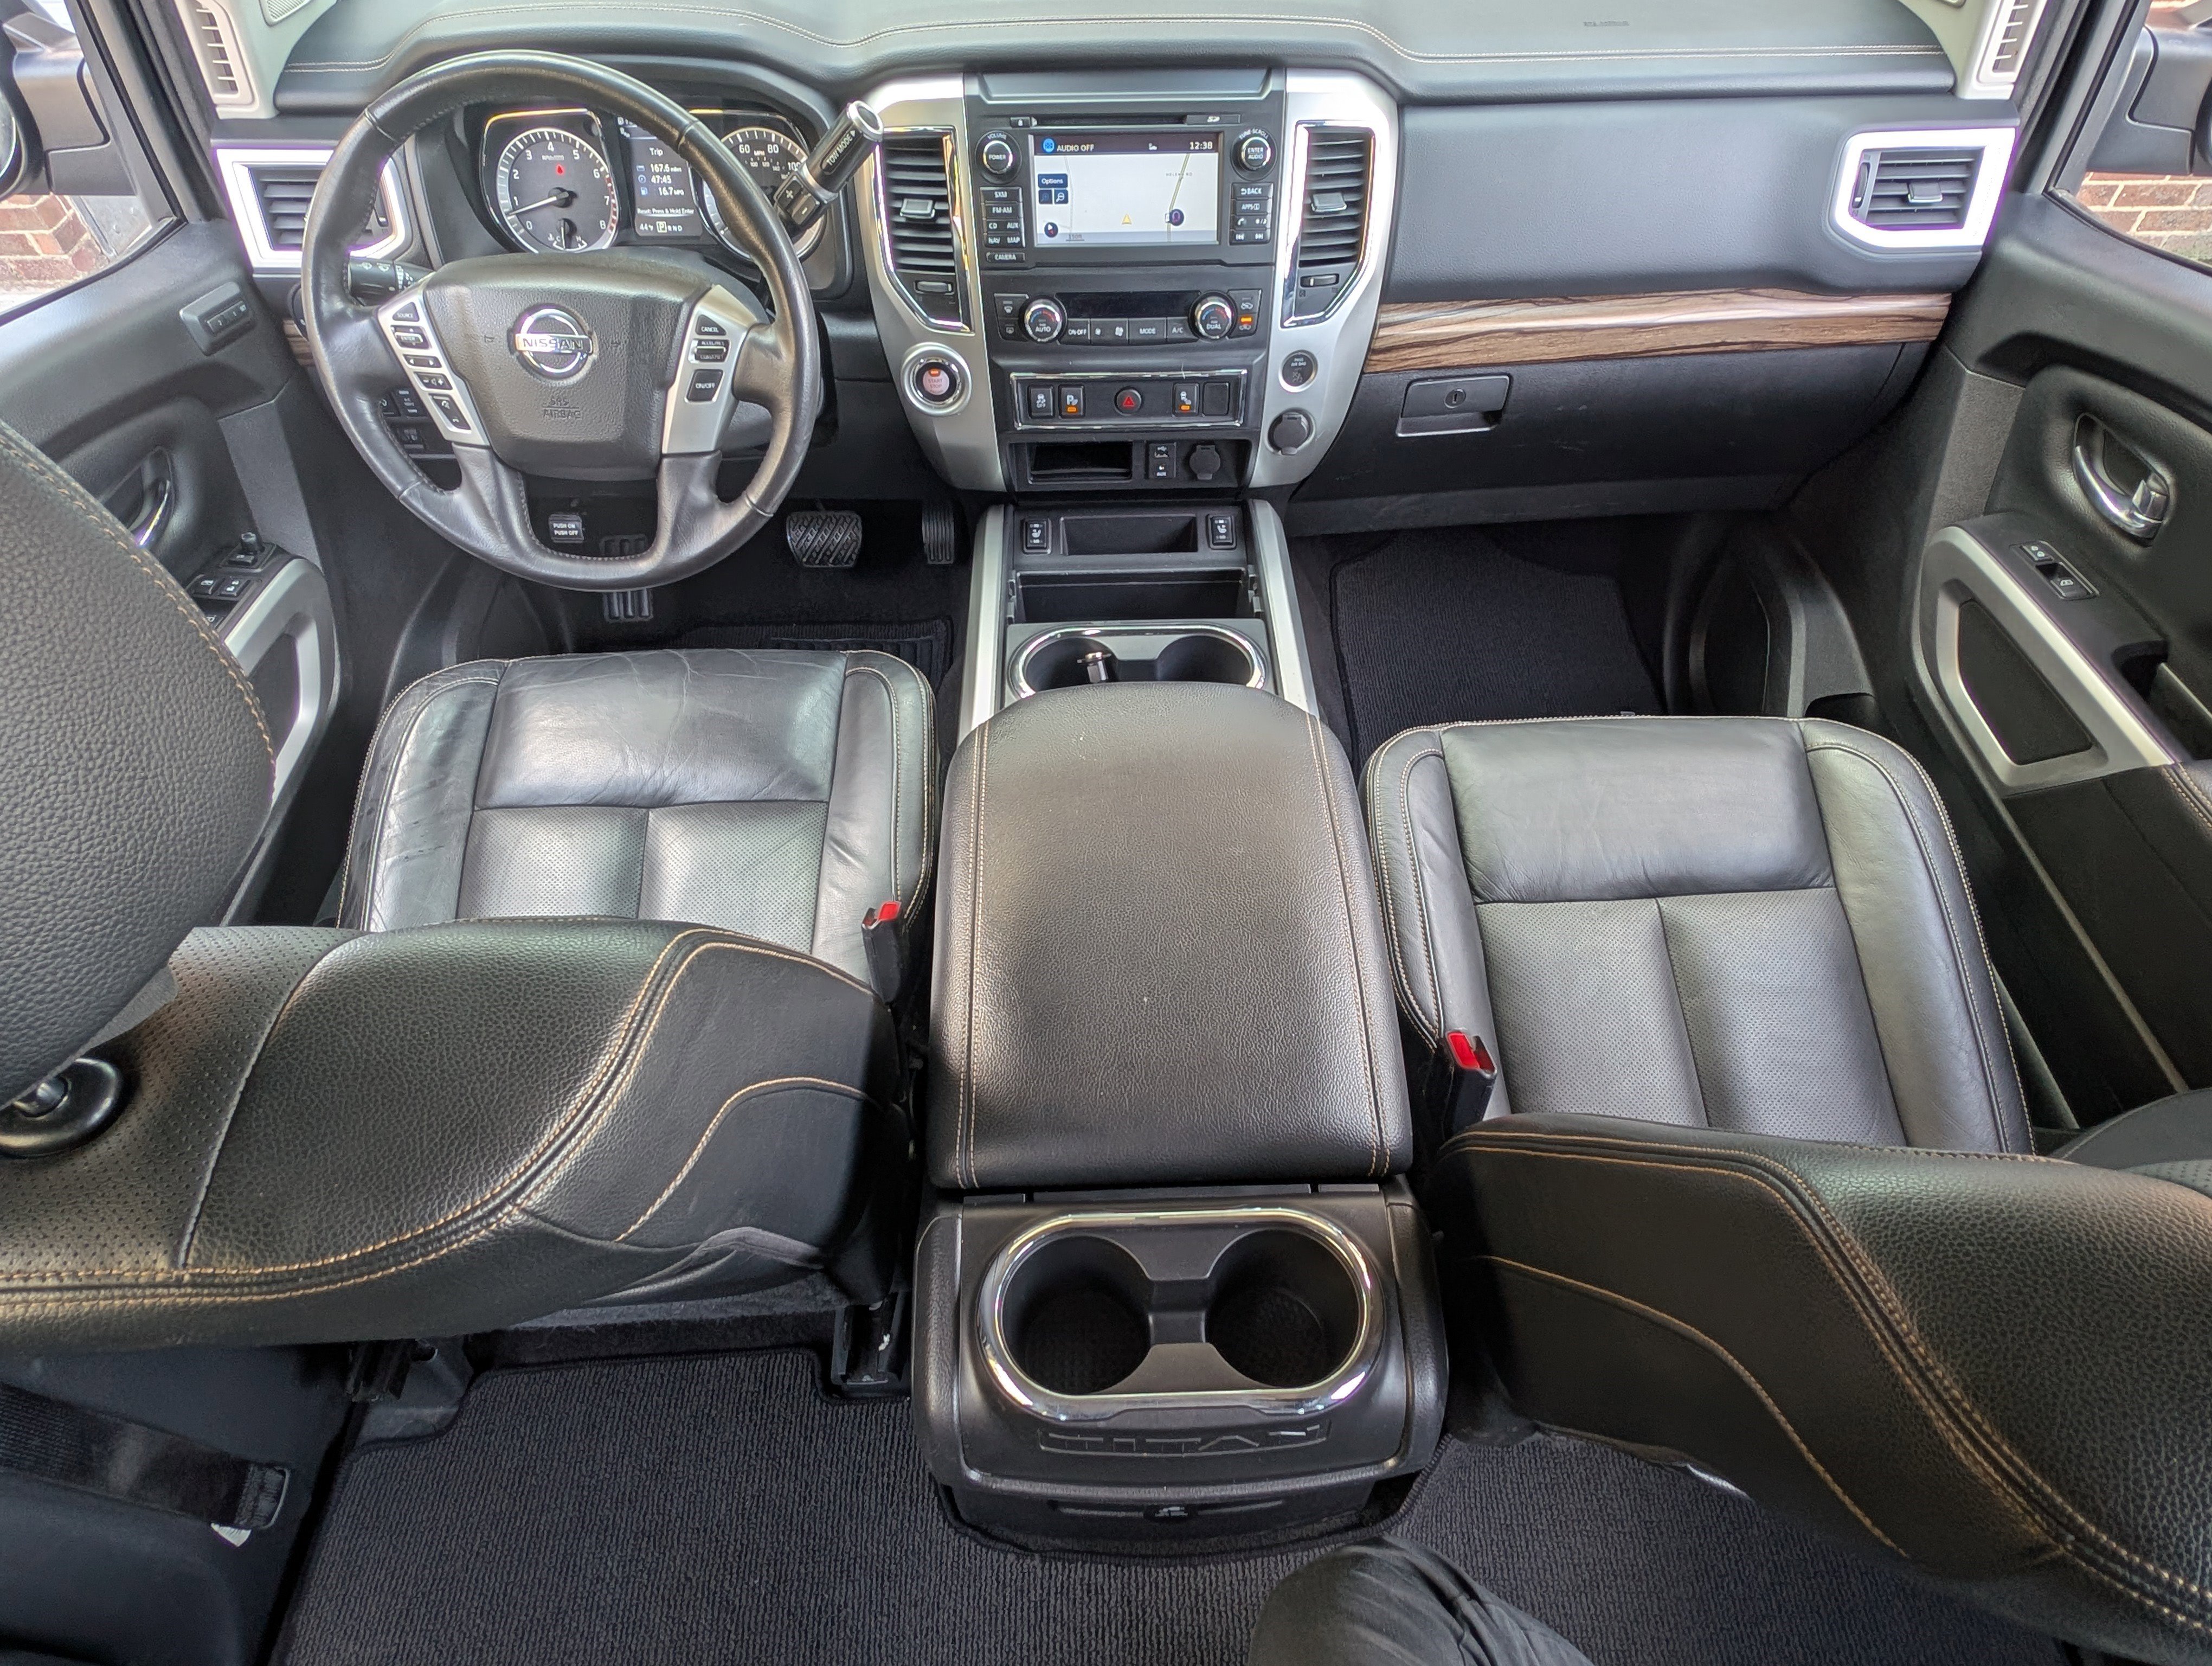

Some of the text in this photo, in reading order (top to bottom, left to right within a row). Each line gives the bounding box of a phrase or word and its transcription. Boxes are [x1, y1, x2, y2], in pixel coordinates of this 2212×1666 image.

[548, 142, 554, 152] 4
[649, 148, 663, 156] Trip
[739, 144, 750, 153] 60
[767, 144, 779, 153] 80
[826, 136, 853, 166] TOW MODE
[525, 150, 532, 160] 3
[573, 150, 580, 159] 5
[513, 169, 519, 180] 2
[593, 169, 600, 178] 6
[513, 196, 519, 206] 1
[604, 196, 610, 206] 7
[526, 221, 532, 230] 0
[600, 220, 606, 230] 8
[523, 337, 583, 350] NISSAN
